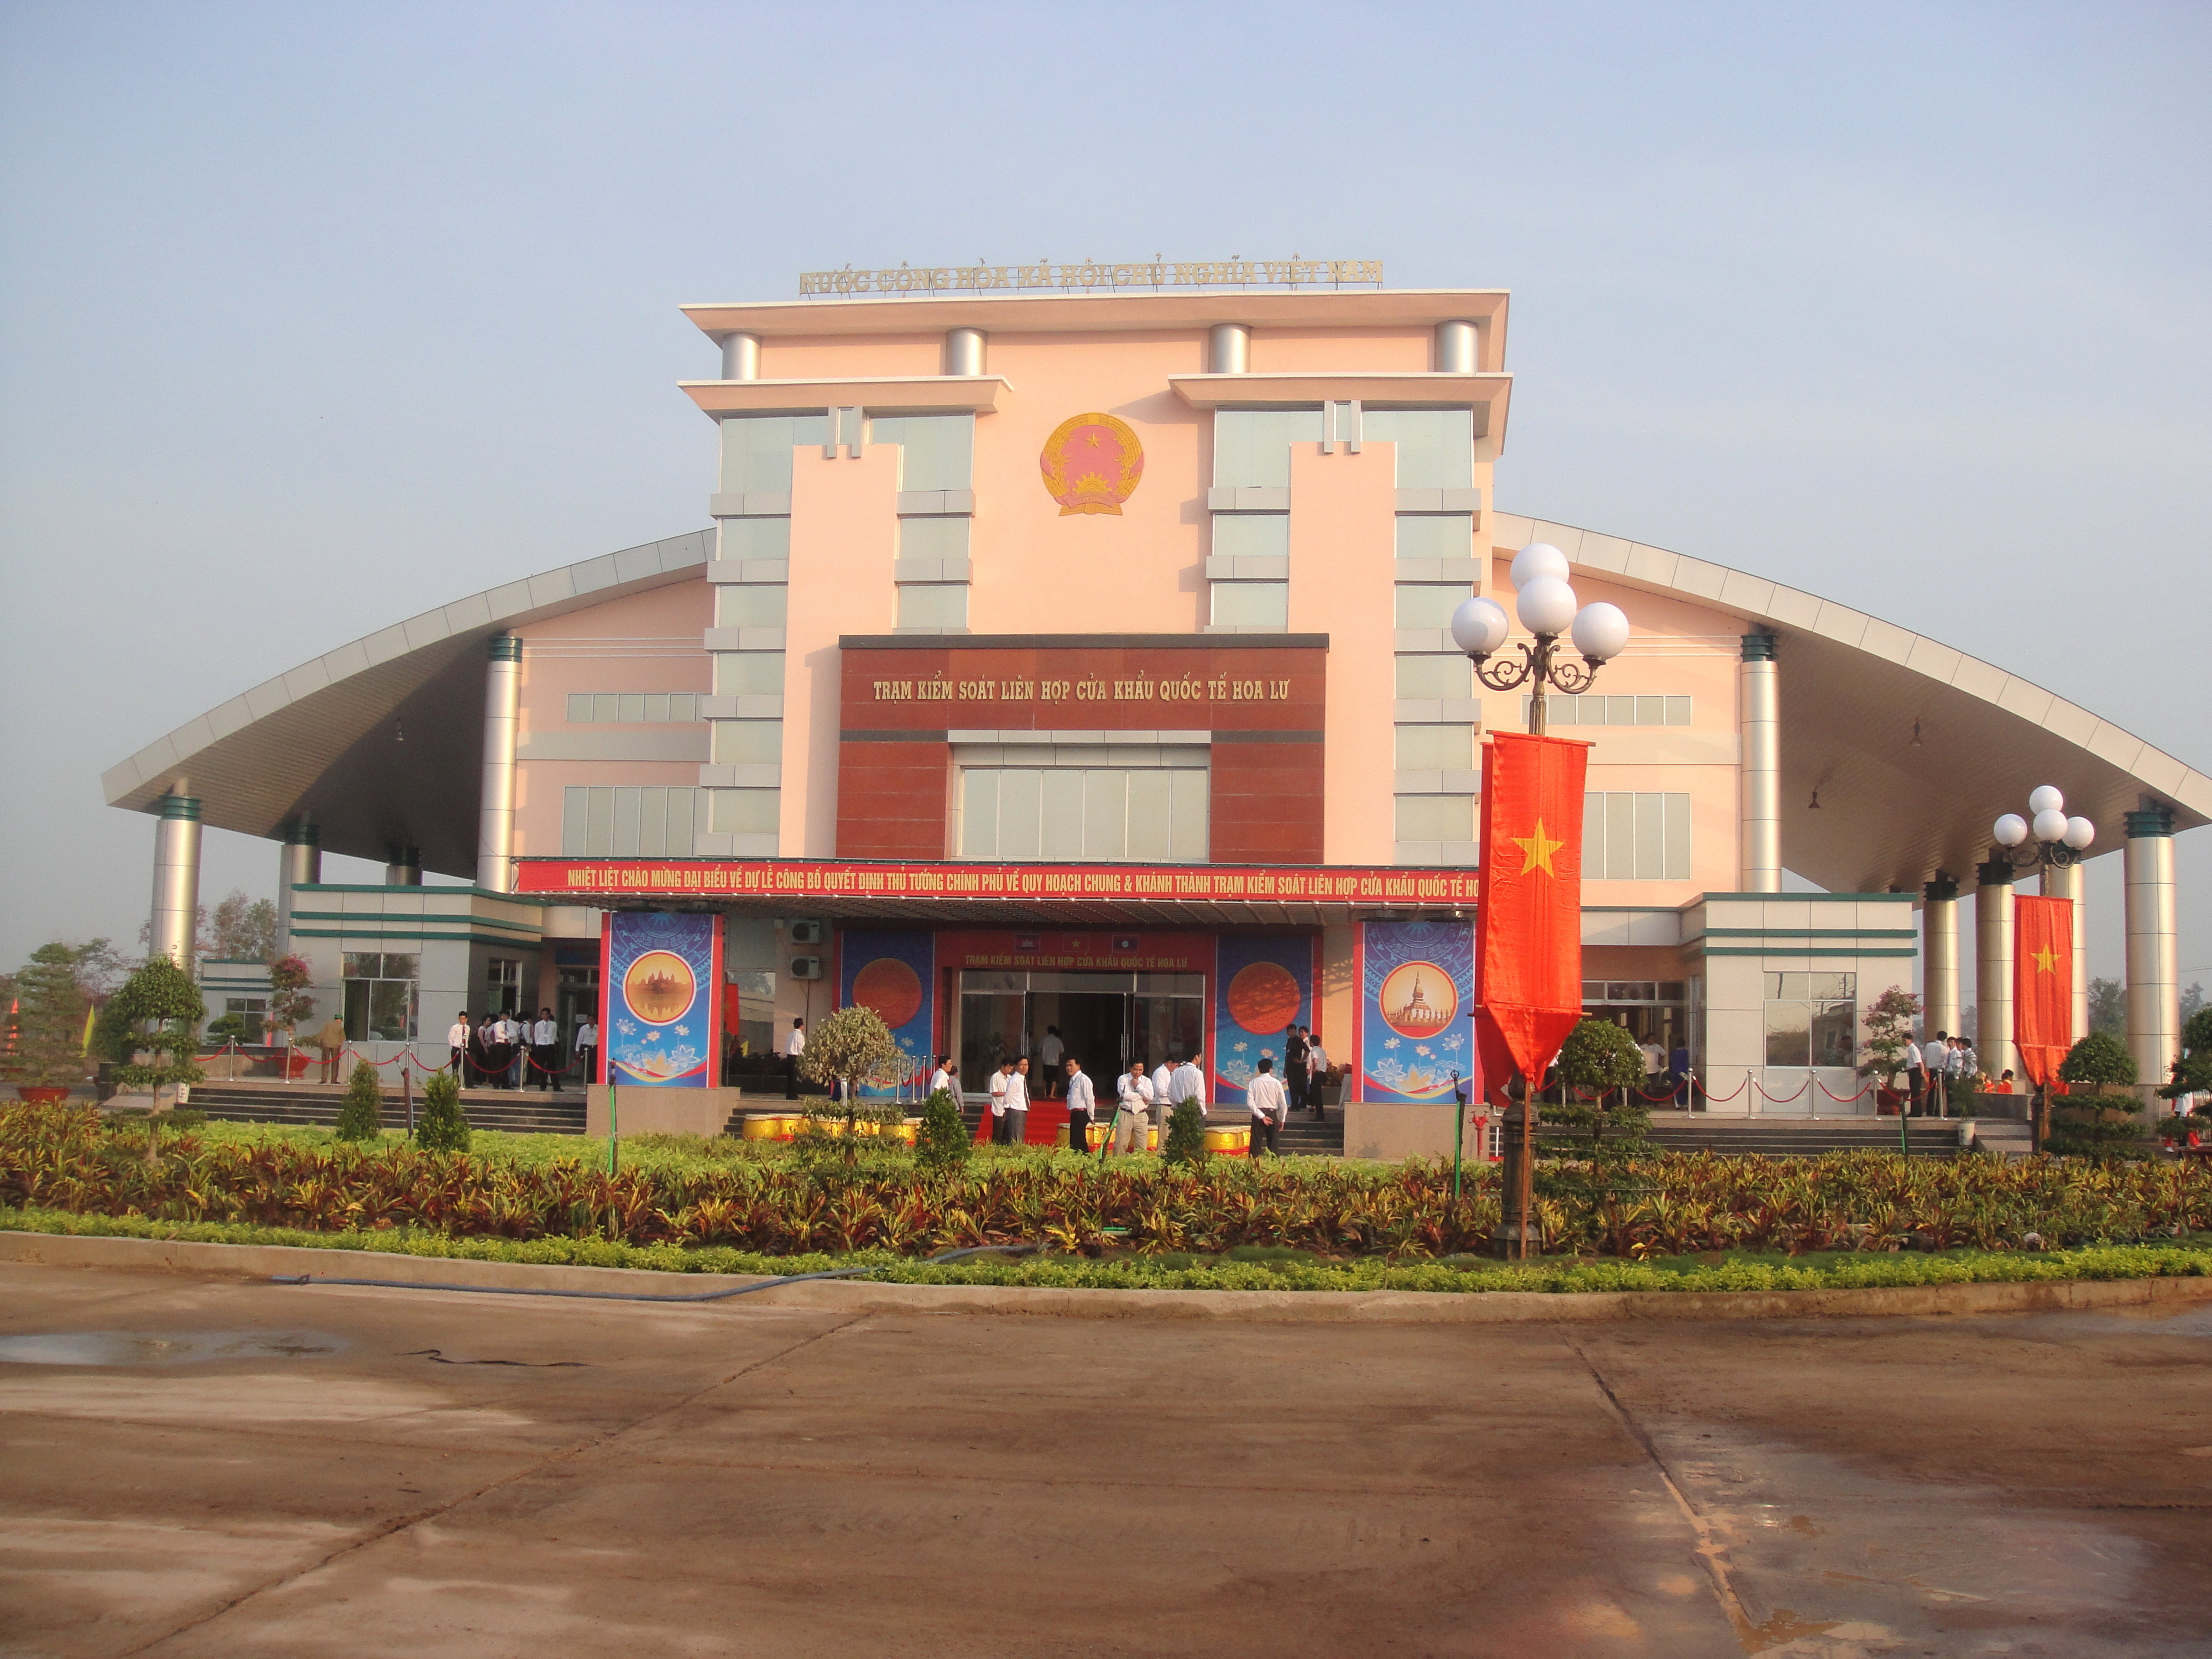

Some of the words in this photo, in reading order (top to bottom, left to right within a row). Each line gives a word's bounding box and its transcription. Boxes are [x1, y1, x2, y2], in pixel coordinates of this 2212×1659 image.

[800, 263, 870, 294] NƯỚC
[877, 261, 951, 298] CỘNG
[956, 257, 1008, 289] HÒA
[1018, 258, 1053, 287] XÃ
[1060, 257, 1105, 294] HỘI
[1113, 252, 1166, 286] CHỦ
[1174, 254, 1258, 284] NGHĨA
[1264, 253, 1320, 290] VIỆT
[1327, 260, 1383, 283] NAM
[873, 681, 912, 704] TRẠM
[917, 670, 953, 700] KIỂM
[958, 674, 995, 700] SOÁT
[1001, 675, 1034, 700] LIÊN
[1041, 680, 1071, 705] HỢP
[1076, 673, 1107, 700] CỬA
[1114, 670, 1154, 700] KHẨU
[1160, 671, 1201, 701] QUỐC
[1208, 672, 1226, 700] TẾ
[1232, 681, 1263, 700] HOA
[1270, 680, 1290, 700] LƯ
[568, 867, 596, 890] NHIỆT
[599, 867, 618, 890] LIỆT
[622, 867, 648, 886] CHÀO
[651, 867, 681, 887] MỪNG
[684, 870, 701, 891] ĐẠI
[704, 864, 727, 888] BIỂU
[730, 865, 742, 888] VỀ
[745, 869, 760, 892] DỰ
[761, 866, 773, 889] LỄ
[776, 868, 804, 889] CÔNG
[807, 867, 822, 889] BỐ
[824, 867, 855, 891] QUYẾT
[858, 873, 884, 894] ĐỊNH
[887, 867, 906, 890] THỦ
[909, 869, 943, 891] TƯỚNG
[947, 870, 979, 891] CHÍNH
[982, 867, 1003, 891] PHỦ
[1006, 868, 1019, 891] VỀ
[1022, 874, 1043, 894] QUY
[1046, 874, 1082, 895] HOẠCH
[1084, 874, 1120, 892] CHUNG
[1125, 875, 1132, 892] &
[1136, 872, 1172, 893] KHÁNH
[1175, 872, 1211, 893] THÀNH
[1214, 876, 1244, 897] TRẠM
[1247, 869, 1275, 894] KIỂM
[1278, 874, 1306, 895] SOÁT
[1308, 874, 1332, 895] LIÊN
[1335, 876, 1357, 899] HỢP
[1360, 871, 1383, 896] CỬA
[1386, 872, 1415, 896] KHẨU
[1418, 873, 1447, 898] QUỐC
[1450, 872, 1463, 897] TẾ
[966, 955, 988, 967] TRẠM
[1014, 954, 1035, 965] SOÁT
[1121, 954, 1143, 968] QUỐC
[1158, 958, 1174, 968] HOA
[1177, 957, 1188, 968] LƯ
